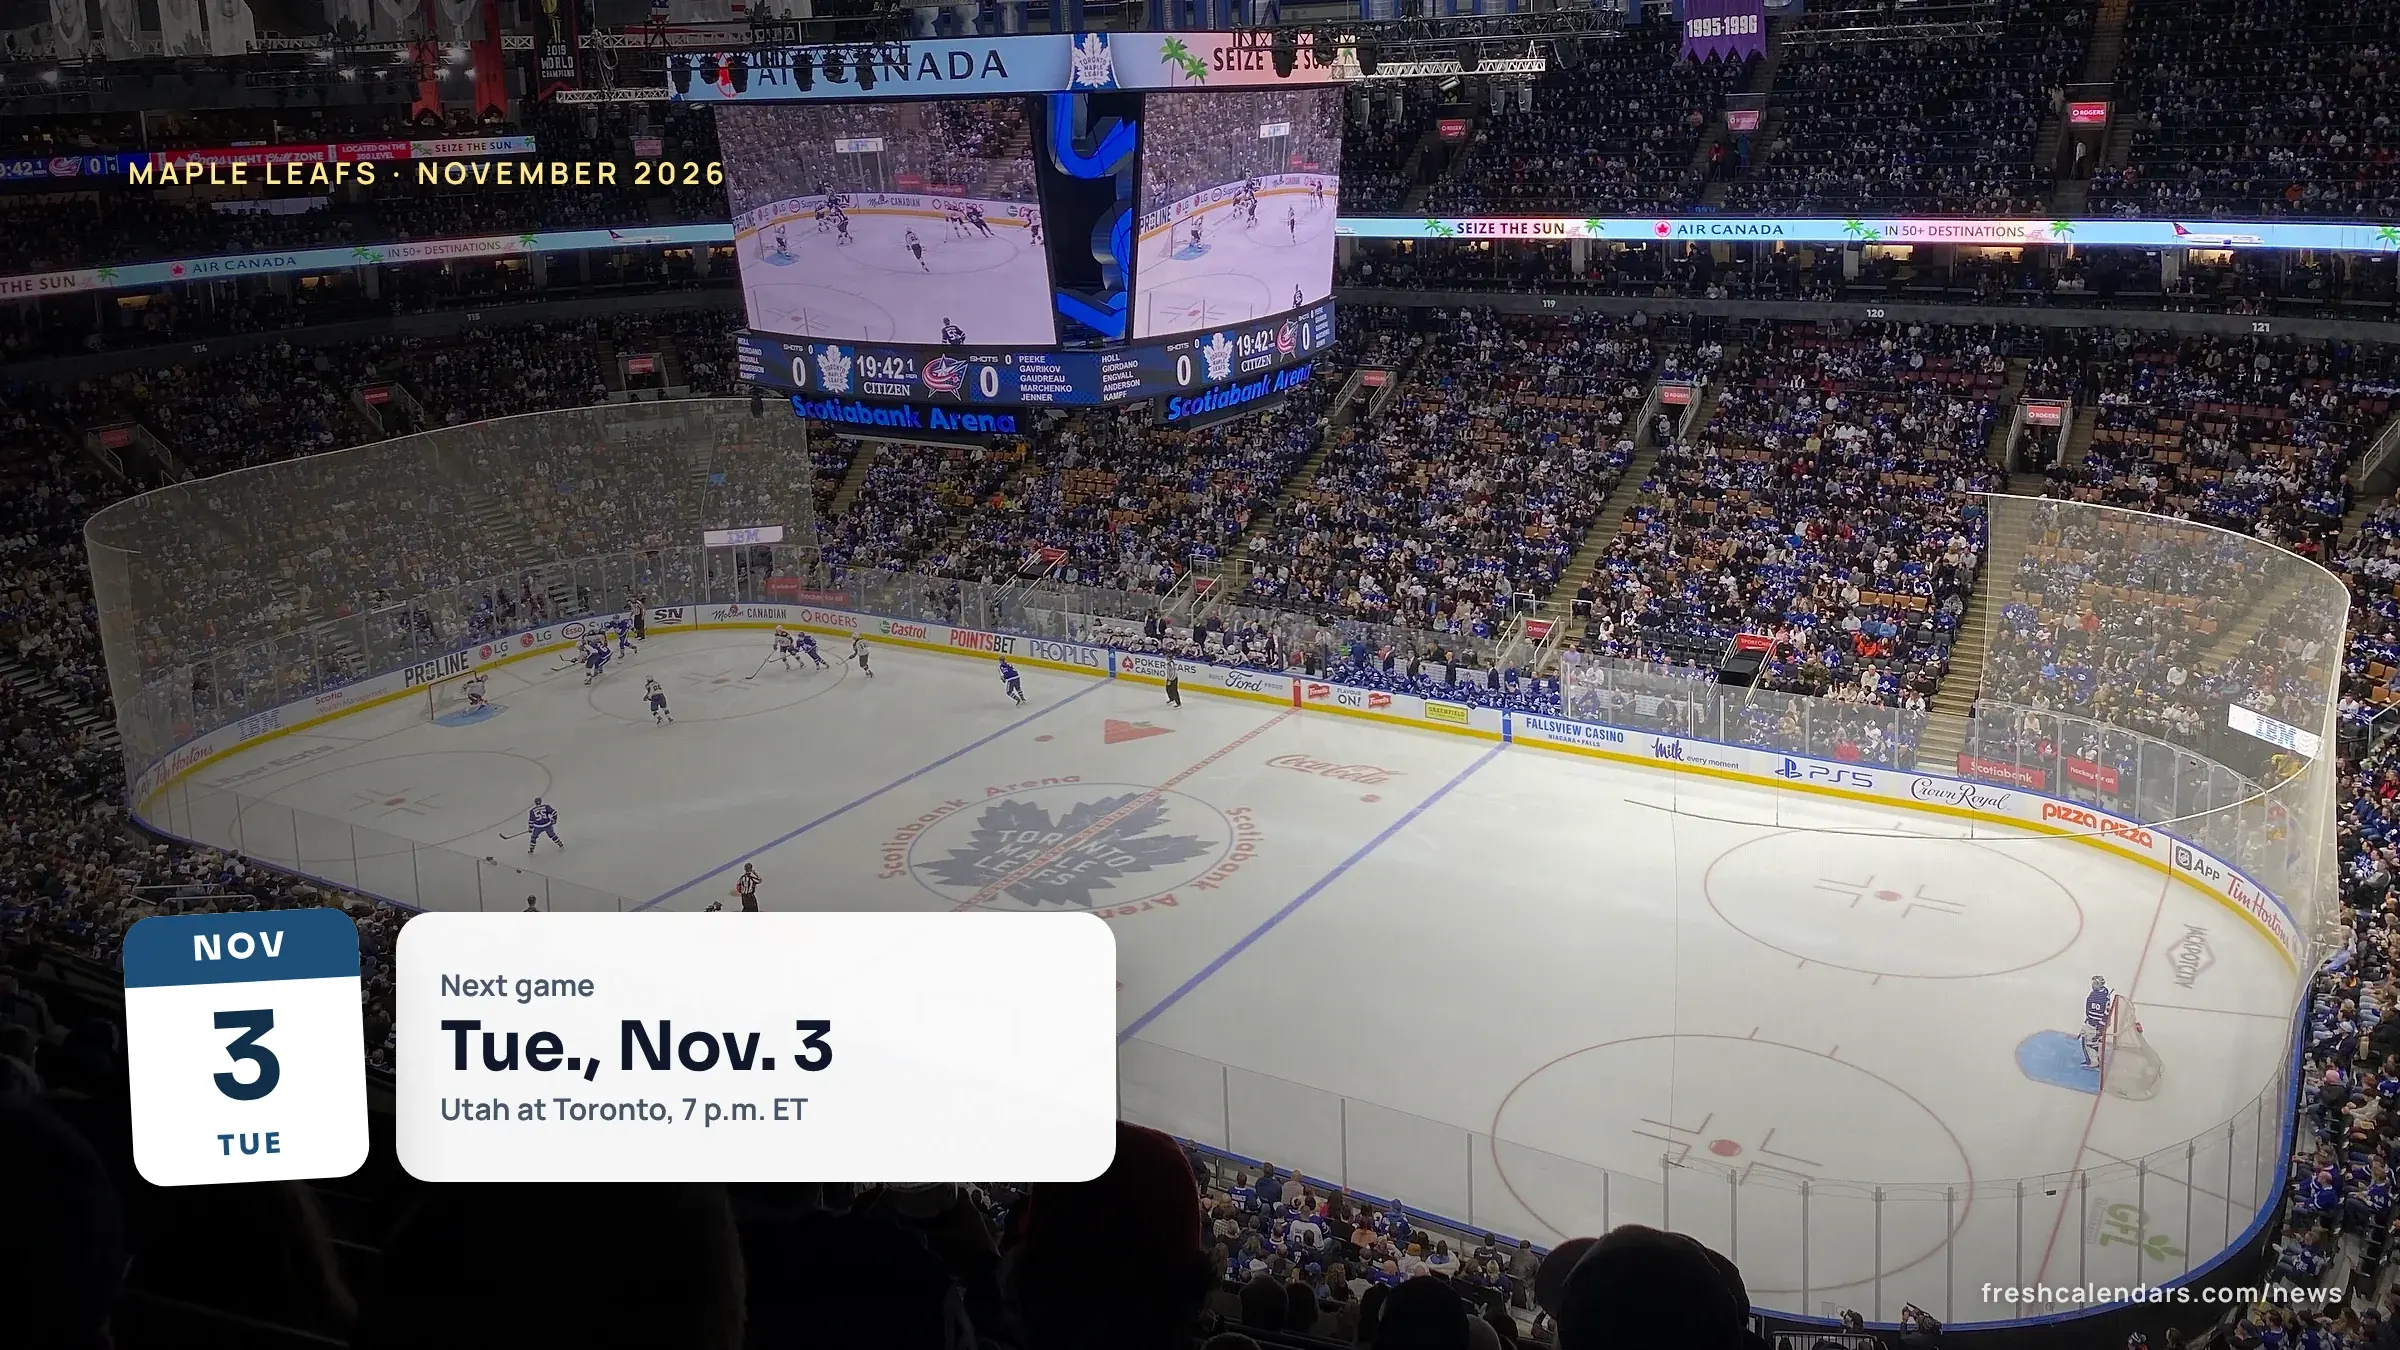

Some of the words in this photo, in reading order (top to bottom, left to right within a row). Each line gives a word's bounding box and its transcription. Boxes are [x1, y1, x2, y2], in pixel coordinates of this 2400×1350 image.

[546, 44, 567, 56] 2019
[540, 56, 574, 69] WORLD
[1079, 56, 1107, 66] TORONTO
[1214, 46, 1264, 72] SEIZE
[541, 69, 575, 78] CHAMPIONS
[342, 145, 378, 154] LOCATED
[379, 144, 391, 152] ON
[435, 143, 465, 153] SEIZE
[467, 142, 487, 152] THE
[489, 140, 512, 150] SUN
[294, 151, 324, 162] ZONE
[370, 152, 395, 161] LEVEL
[1457, 222, 1495, 235] SEIZE
[1500, 222, 1528, 235] THE
[1533, 222, 1565, 235] SUN
[1677, 224, 1706, 235] AIR
[1710, 224, 1784, 235] CANADA
[1884, 225, 1898, 237] IN
[1902, 225, 1925, 237] 50+
[1928, 225, 2025, 238] DESTINATIONS
[388, 247, 399, 259] IN
[402, 246, 422, 257] 50+
[425, 241, 502, 256] DESTINATIONS
[192, 260, 220, 275] AIR
[225, 255, 298, 272] CANADA
[1, 279, 33, 295] THE
[39, 275, 76, 290] SUN
[1542, 300, 1557, 310] 119
[1866, 308, 1885, 320] 120
[2251, 321, 2271, 333] 121
[1236, 330, 1268, 358] 19:42
[1268, 328, 1274, 341] 1
[1302, 322, 1311, 351] 0
[808, 344, 814, 355] 0
[1166, 342, 1190, 352] SHOTS
[969, 354, 999, 364] SHOTS
[1004, 353, 1012, 365] 0
[1018, 354, 1046, 364] PEEKE
[1101, 353, 1121, 364] HOLL
[1240, 353, 1272, 373] CITIZEN
[792, 356, 806, 387] 0
[856, 354, 905, 380] 19:42
[906, 358, 913, 372] 1
[1019, 364, 1061, 374] GAVRIKOV
[1101, 359, 1139, 374] GIORDANO
[1176, 354, 1192, 387] 0
[979, 365, 999, 398] 0
[1019, 374, 1066, 383] GAUDREAU
[1102, 370, 1134, 383] ENGVALL
[863, 381, 911, 397] CITIZEN
[1020, 383, 1073, 393] MARCHENKO
[1102, 379, 1141, 393] ANDERSON
[1168, 374, 1272, 421] Scotiabank
[1273, 363, 1313, 393] Arena
[1020, 393, 1053, 402] JENNER
[1103, 390, 1128, 402] KAMPF
[790, 394, 923, 429] Scotiabank
[929, 406, 1016, 433] Arena
[726, 529, 760, 543] IBM
[654, 607, 684, 621] SN
[711, 604, 744, 622] Molson
[747, 608, 787, 619] CANADIAN
[815, 611, 858, 629] ROGERS
[536, 630, 553, 644] LG
[564, 624, 584, 637] Esso
[891, 621, 927, 640] Castrol
[493, 641, 509, 656] LG
[949, 628, 1017, 655] POINTSBET
[1029, 639, 1099, 668] PEOPLES
[404, 650, 469, 688] PROLINE
[1135, 667, 1166, 678] CASINO
[1208, 673, 1225, 681] BUILT
[1225, 670, 1263, 693] Ford
[1264, 682, 1283, 690] PROUD
[314, 690, 344, 706] Scotia
[1336, 687, 1362, 696] FLAVOUR
[1337, 694, 1362, 707] ON!
[317, 702, 342, 715] Wealth
[1428, 706, 1466, 718] GREENFIELD
[238, 708, 282, 742] IBM
[1526, 717, 1582, 737] FALLSVIEW
[1585, 727, 1624, 744] CASINO
[2255, 715, 2297, 749] IBM
[1548, 733, 1576, 744] NIAGARA
[1581, 739, 1601, 748] FALLS
[1650, 736, 1685, 762] Milk
[1686, 754, 1707, 764] every
[1707, 758, 1739, 770] moment
[154, 762, 172, 787] Tim
[170, 744, 214, 777] Hortons
[1970, 760, 2033, 784] Scotiabank
[1808, 764, 1874, 789] PS5
[2070, 765, 2095, 779] hockey
[2104, 775, 2115, 785] all
[1911, 777, 1957, 804] Crown
[1946, 783, 2011, 811] Royal
[878, 798, 970, 881] Scotiabank
[985, 774, 1081, 799] Arena
[2042, 802, 2097, 830] pizza
[2100, 818, 2153, 849] pizza
[1190, 806, 1264, 892] Scotiabank
[2193, 859, 2220, 882] App
[2227, 872, 2252, 909] Tim
[2252, 891, 2290, 946] Hortons
